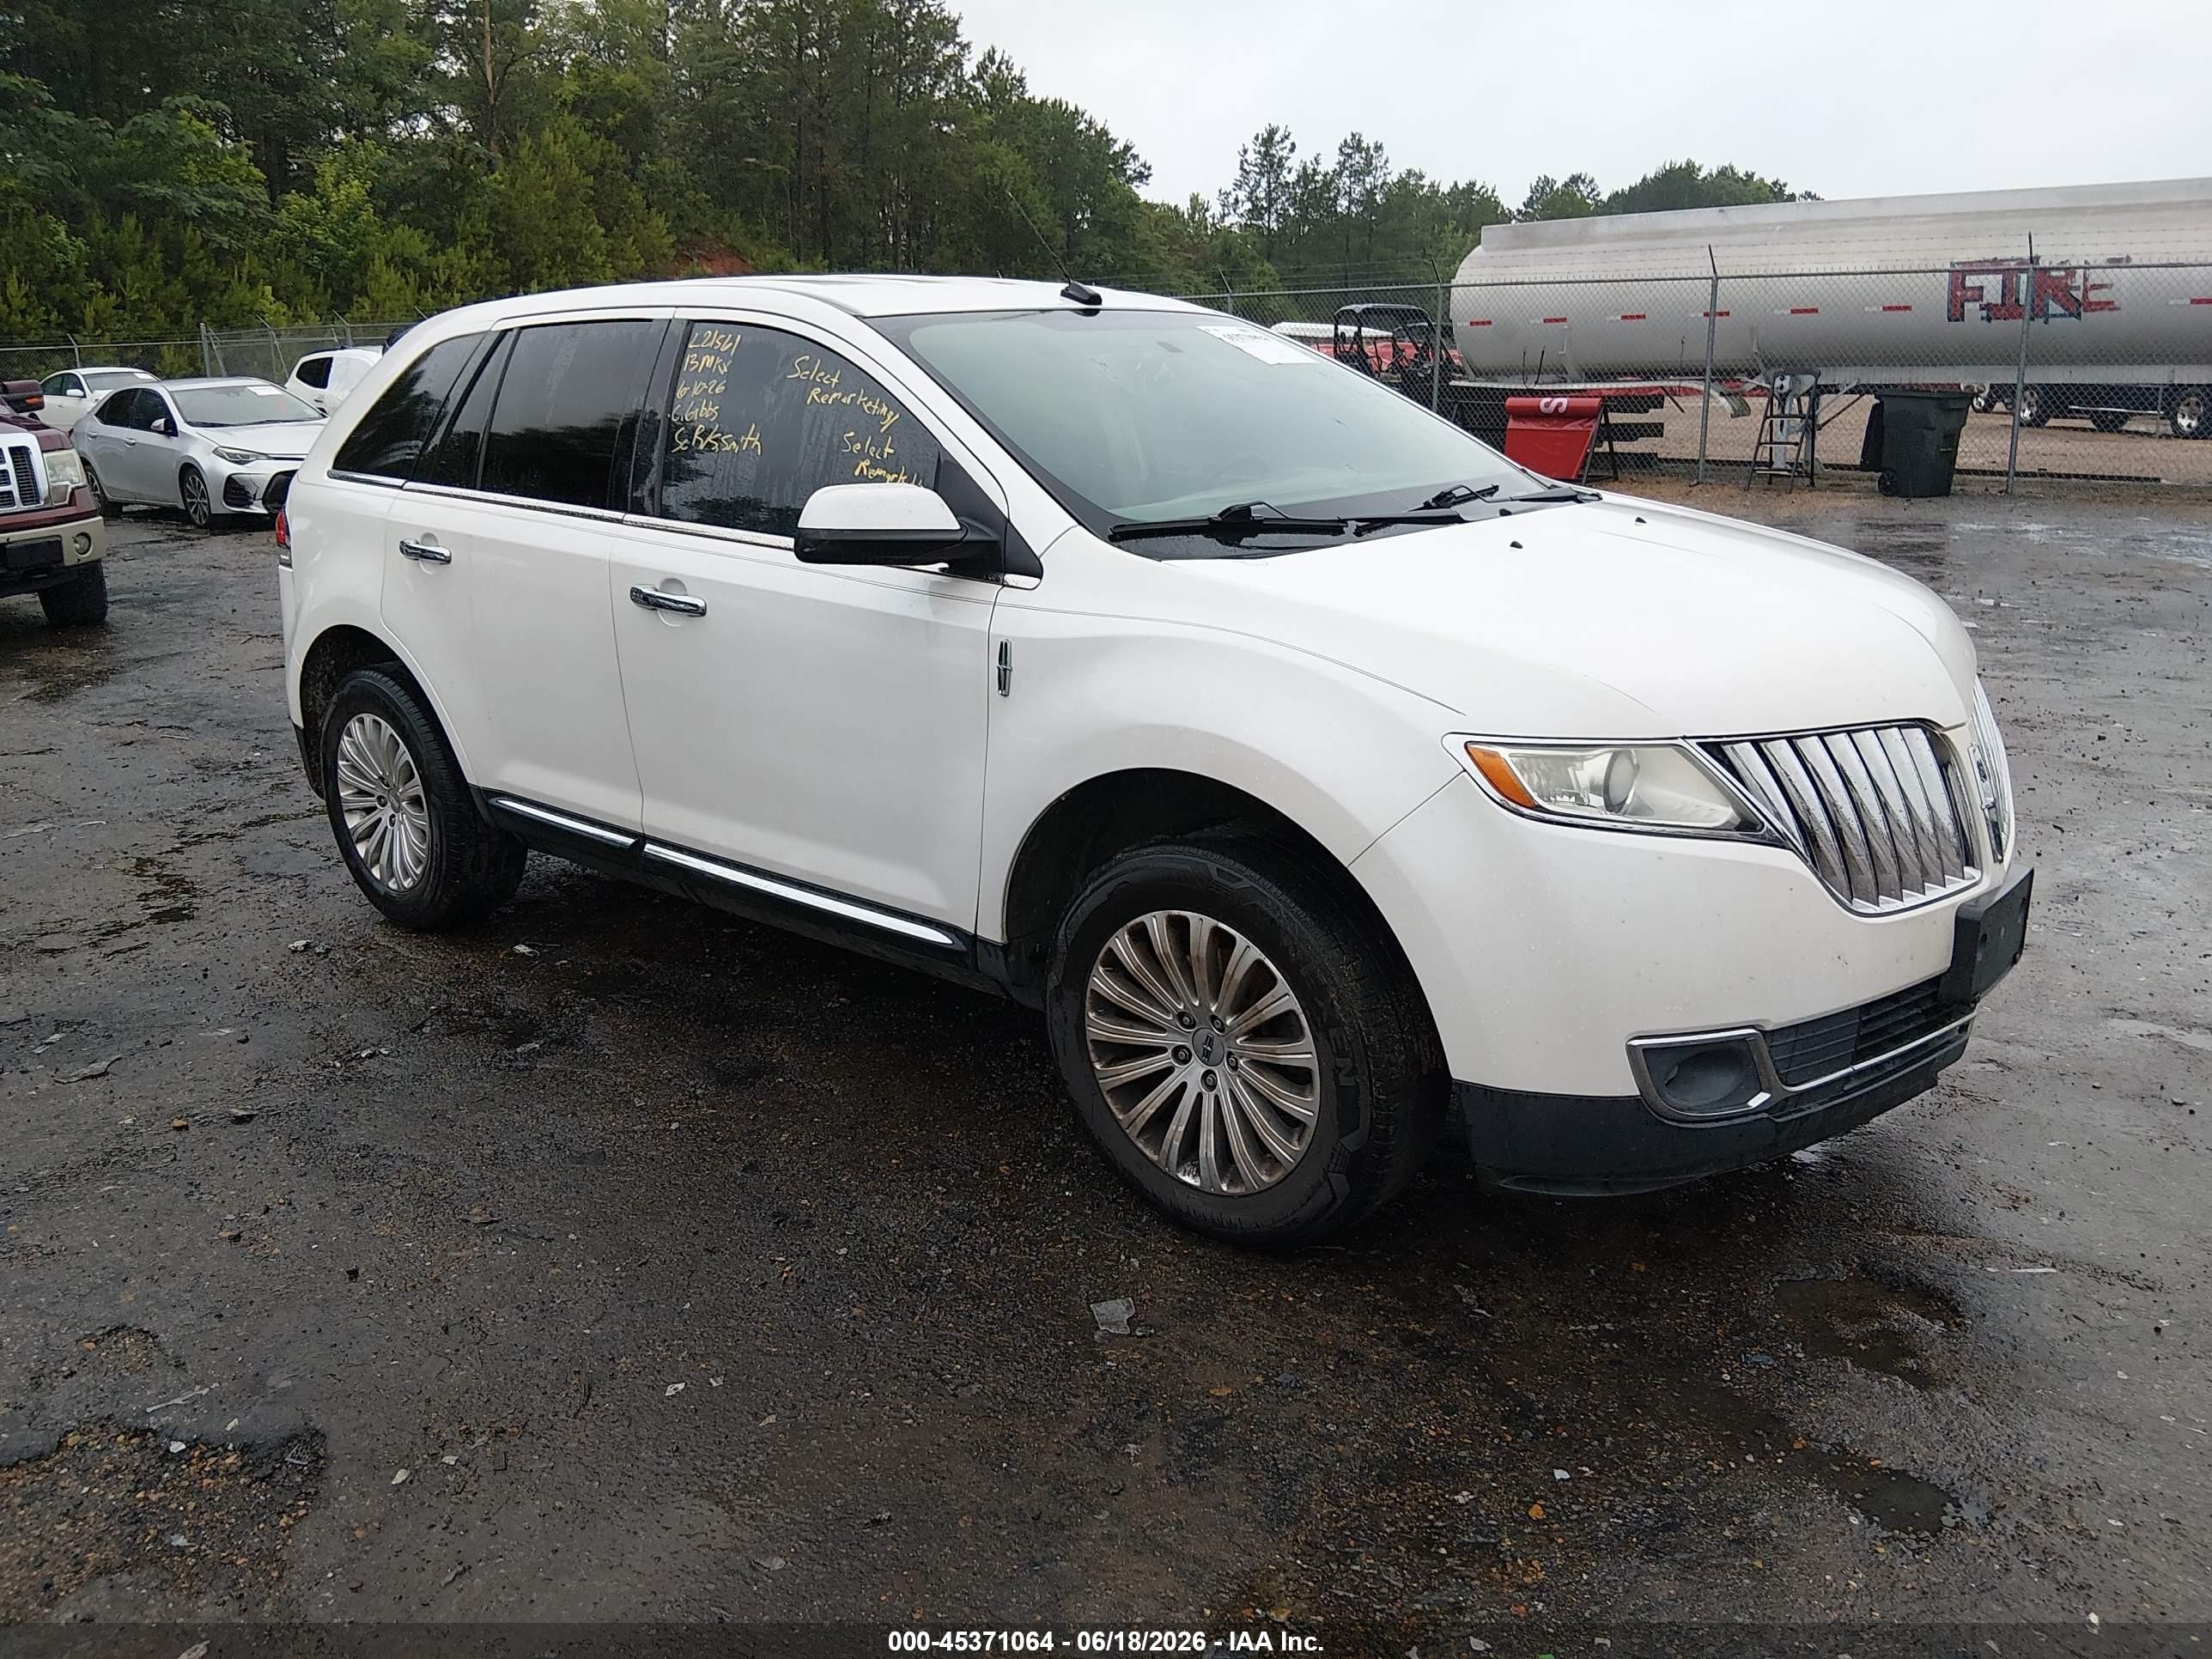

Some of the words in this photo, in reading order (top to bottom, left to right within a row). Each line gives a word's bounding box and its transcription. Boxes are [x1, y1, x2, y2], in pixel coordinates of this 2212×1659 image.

[1947, 255, 2131, 324] FIRE
[787, 355, 842, 389] Select
[842, 431, 895, 459] Select
